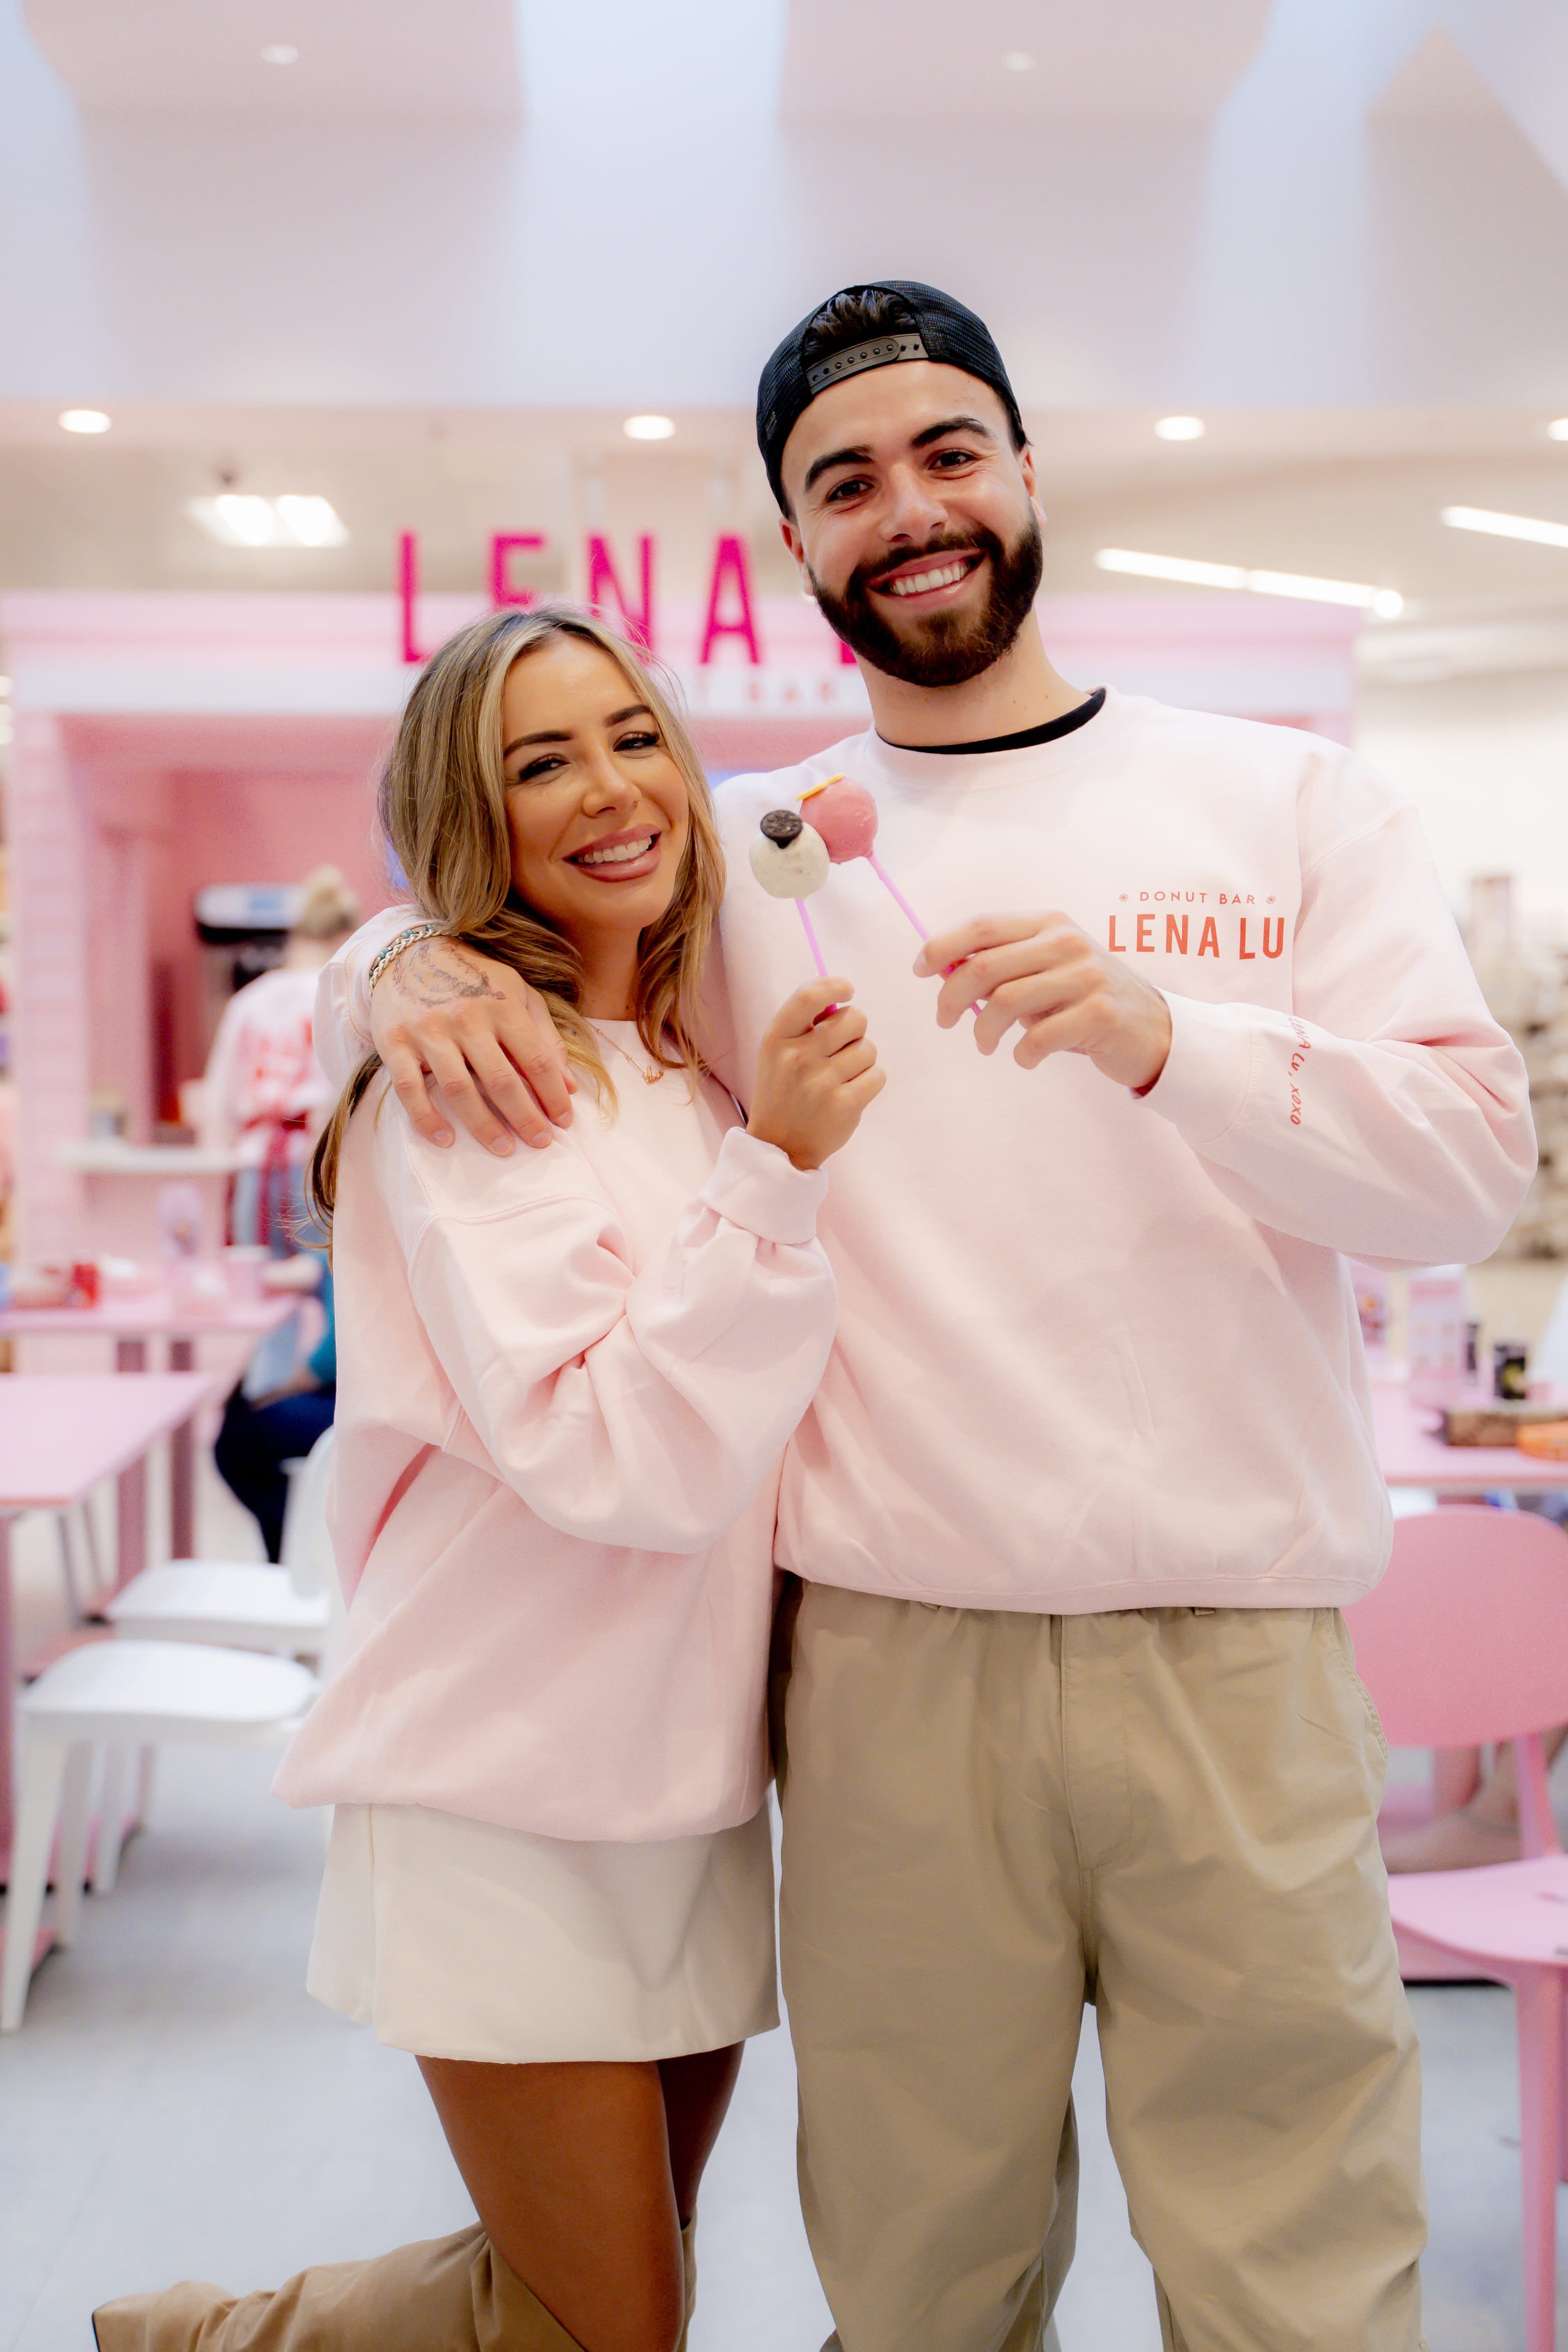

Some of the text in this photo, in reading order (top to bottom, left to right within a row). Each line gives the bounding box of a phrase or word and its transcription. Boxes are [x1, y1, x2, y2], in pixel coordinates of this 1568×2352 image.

[395, 530, 760, 665] LENA
[1139, 891, 1256, 905] DONUT BAR
[1108, 913, 1285, 960] LENA LU
